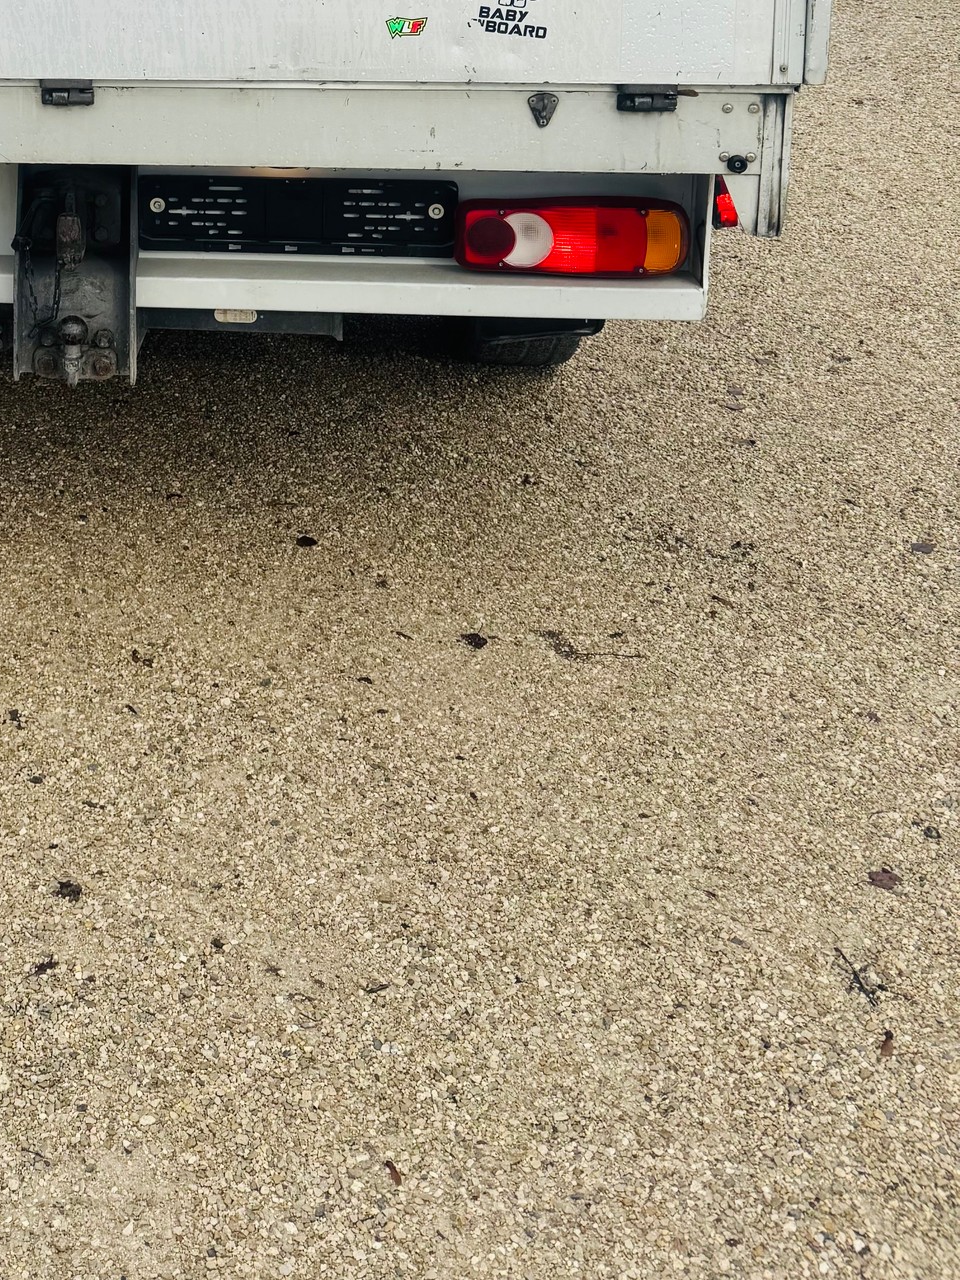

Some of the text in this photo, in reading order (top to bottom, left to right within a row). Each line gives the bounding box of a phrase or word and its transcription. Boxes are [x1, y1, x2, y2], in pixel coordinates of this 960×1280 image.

[479, 6, 529, 22] BABY
[389, 19, 424, 34] WLF
[485, 20, 547, 39] BOARD
